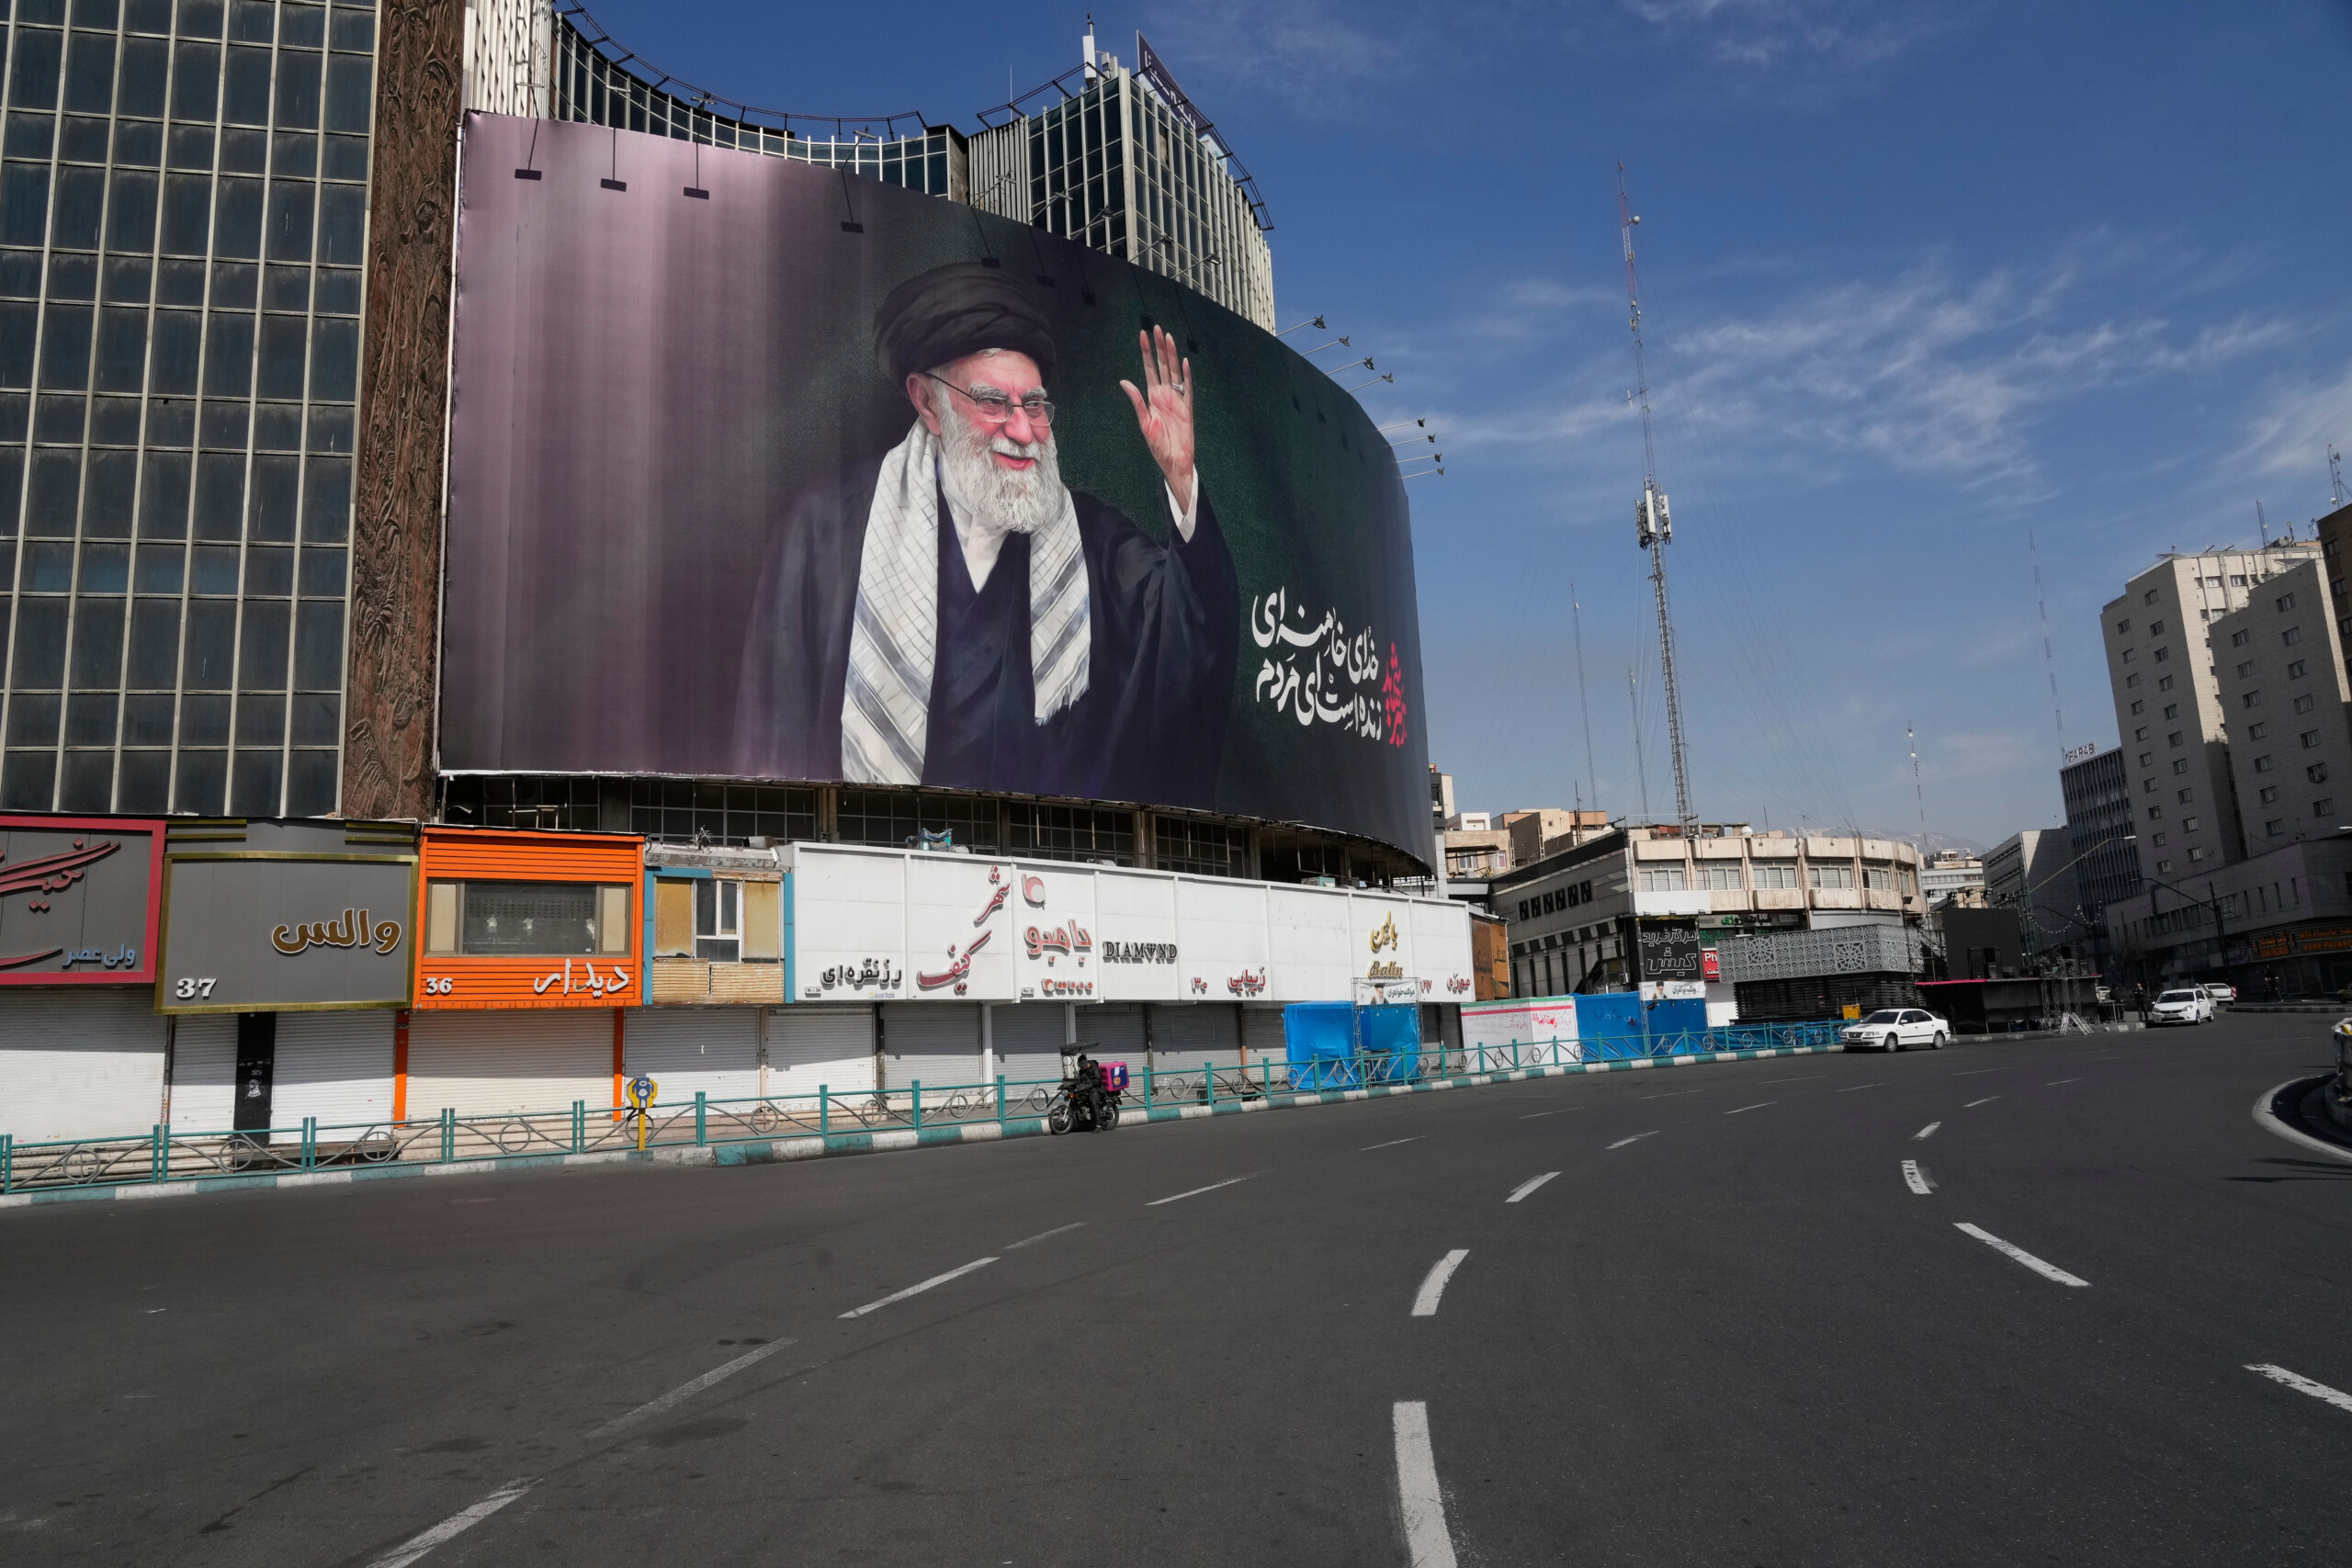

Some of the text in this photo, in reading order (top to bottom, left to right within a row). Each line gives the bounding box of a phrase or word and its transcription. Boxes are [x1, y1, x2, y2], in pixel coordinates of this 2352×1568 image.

[1347, 625, 1379, 684] خدای
[1255, 653, 1301, 713] مردم
[1359, 694, 1382, 741] زنده
[2068, 743, 2095, 761] FARAB
[975, 865, 1011, 922] شهر
[272, 908, 401, 953] والس
[1642, 927, 1699, 948] مرکز خرید
[62, 947, 102, 966] عصر
[103, 943, 136, 966] ولی
[919, 930, 992, 992] کیف
[1645, 946, 1698, 977] کیش
[535, 958, 630, 998] دیدار
[1229, 965, 1266, 992] زیبایی
[1367, 960, 1404, 980] Balin
[175, 977, 218, 999] 37
[425, 976, 453, 995] 36
